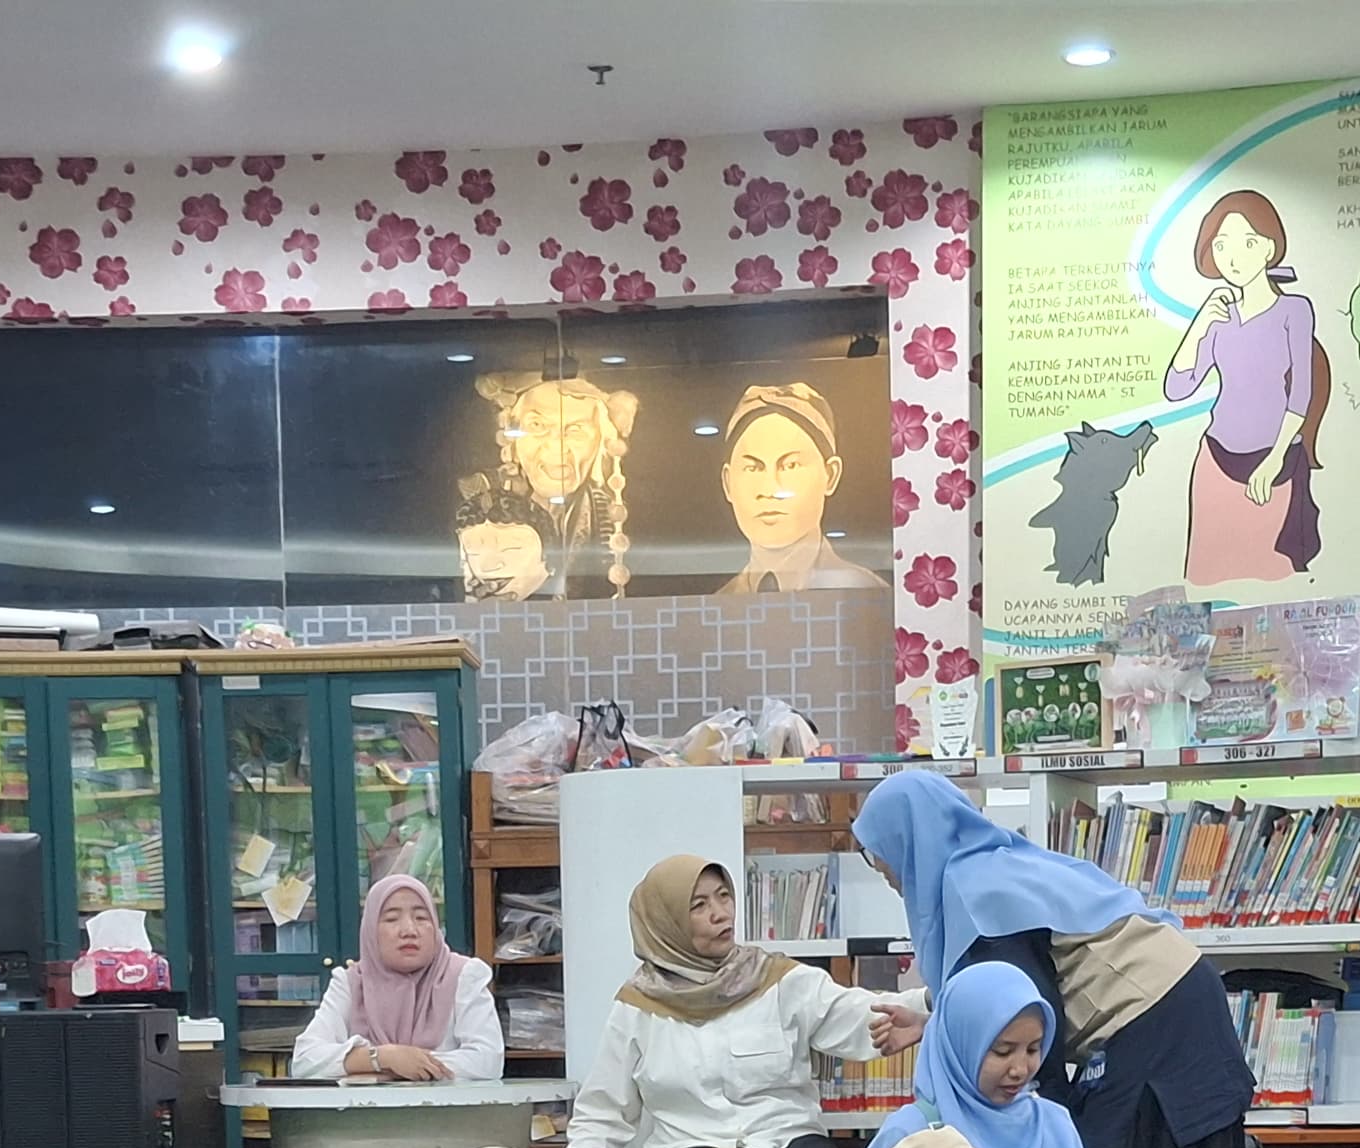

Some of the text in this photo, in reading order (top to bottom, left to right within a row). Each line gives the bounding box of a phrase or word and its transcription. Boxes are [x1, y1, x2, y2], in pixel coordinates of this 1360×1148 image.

[1112, 104, 1149, 117] YANG
[1122, 118, 1168, 133] JARUM
[1008, 155, 1076, 169] PEREMPUA
[1008, 221, 1042, 232] KATA
[1064, 261, 1155, 276] TERKEJUTNYA
[1008, 279, 1119, 294] IA SAAT SEEKOR
[1008, 292, 1147, 309] ANJING JANTANLAH
[1008, 308, 1156, 325] YANG MENGAMBILKAN
[1008, 325, 1129, 341] JARUM RAJUTNYA
[1008, 355, 1150, 372] ANJING JANTAN ITU
[1008, 370, 1158, 388] KEMUDIAN DIPANGGIL
[1008, 390, 1063, 403] DENGAN
[1067, 388, 1106, 400] NAMA
[1004, 599, 1058, 611] DAYANG
[1063, 596, 1106, 608] SUMBI
[1004, 613, 1082, 625] UCAPANNYA
[1004, 644, 1059, 656] JANTAN
[1224, 746, 1246, 759] 306
[1256, 745, 1276, 758] 327
[1041, 755, 1105, 768] ILMU SOSIAL
